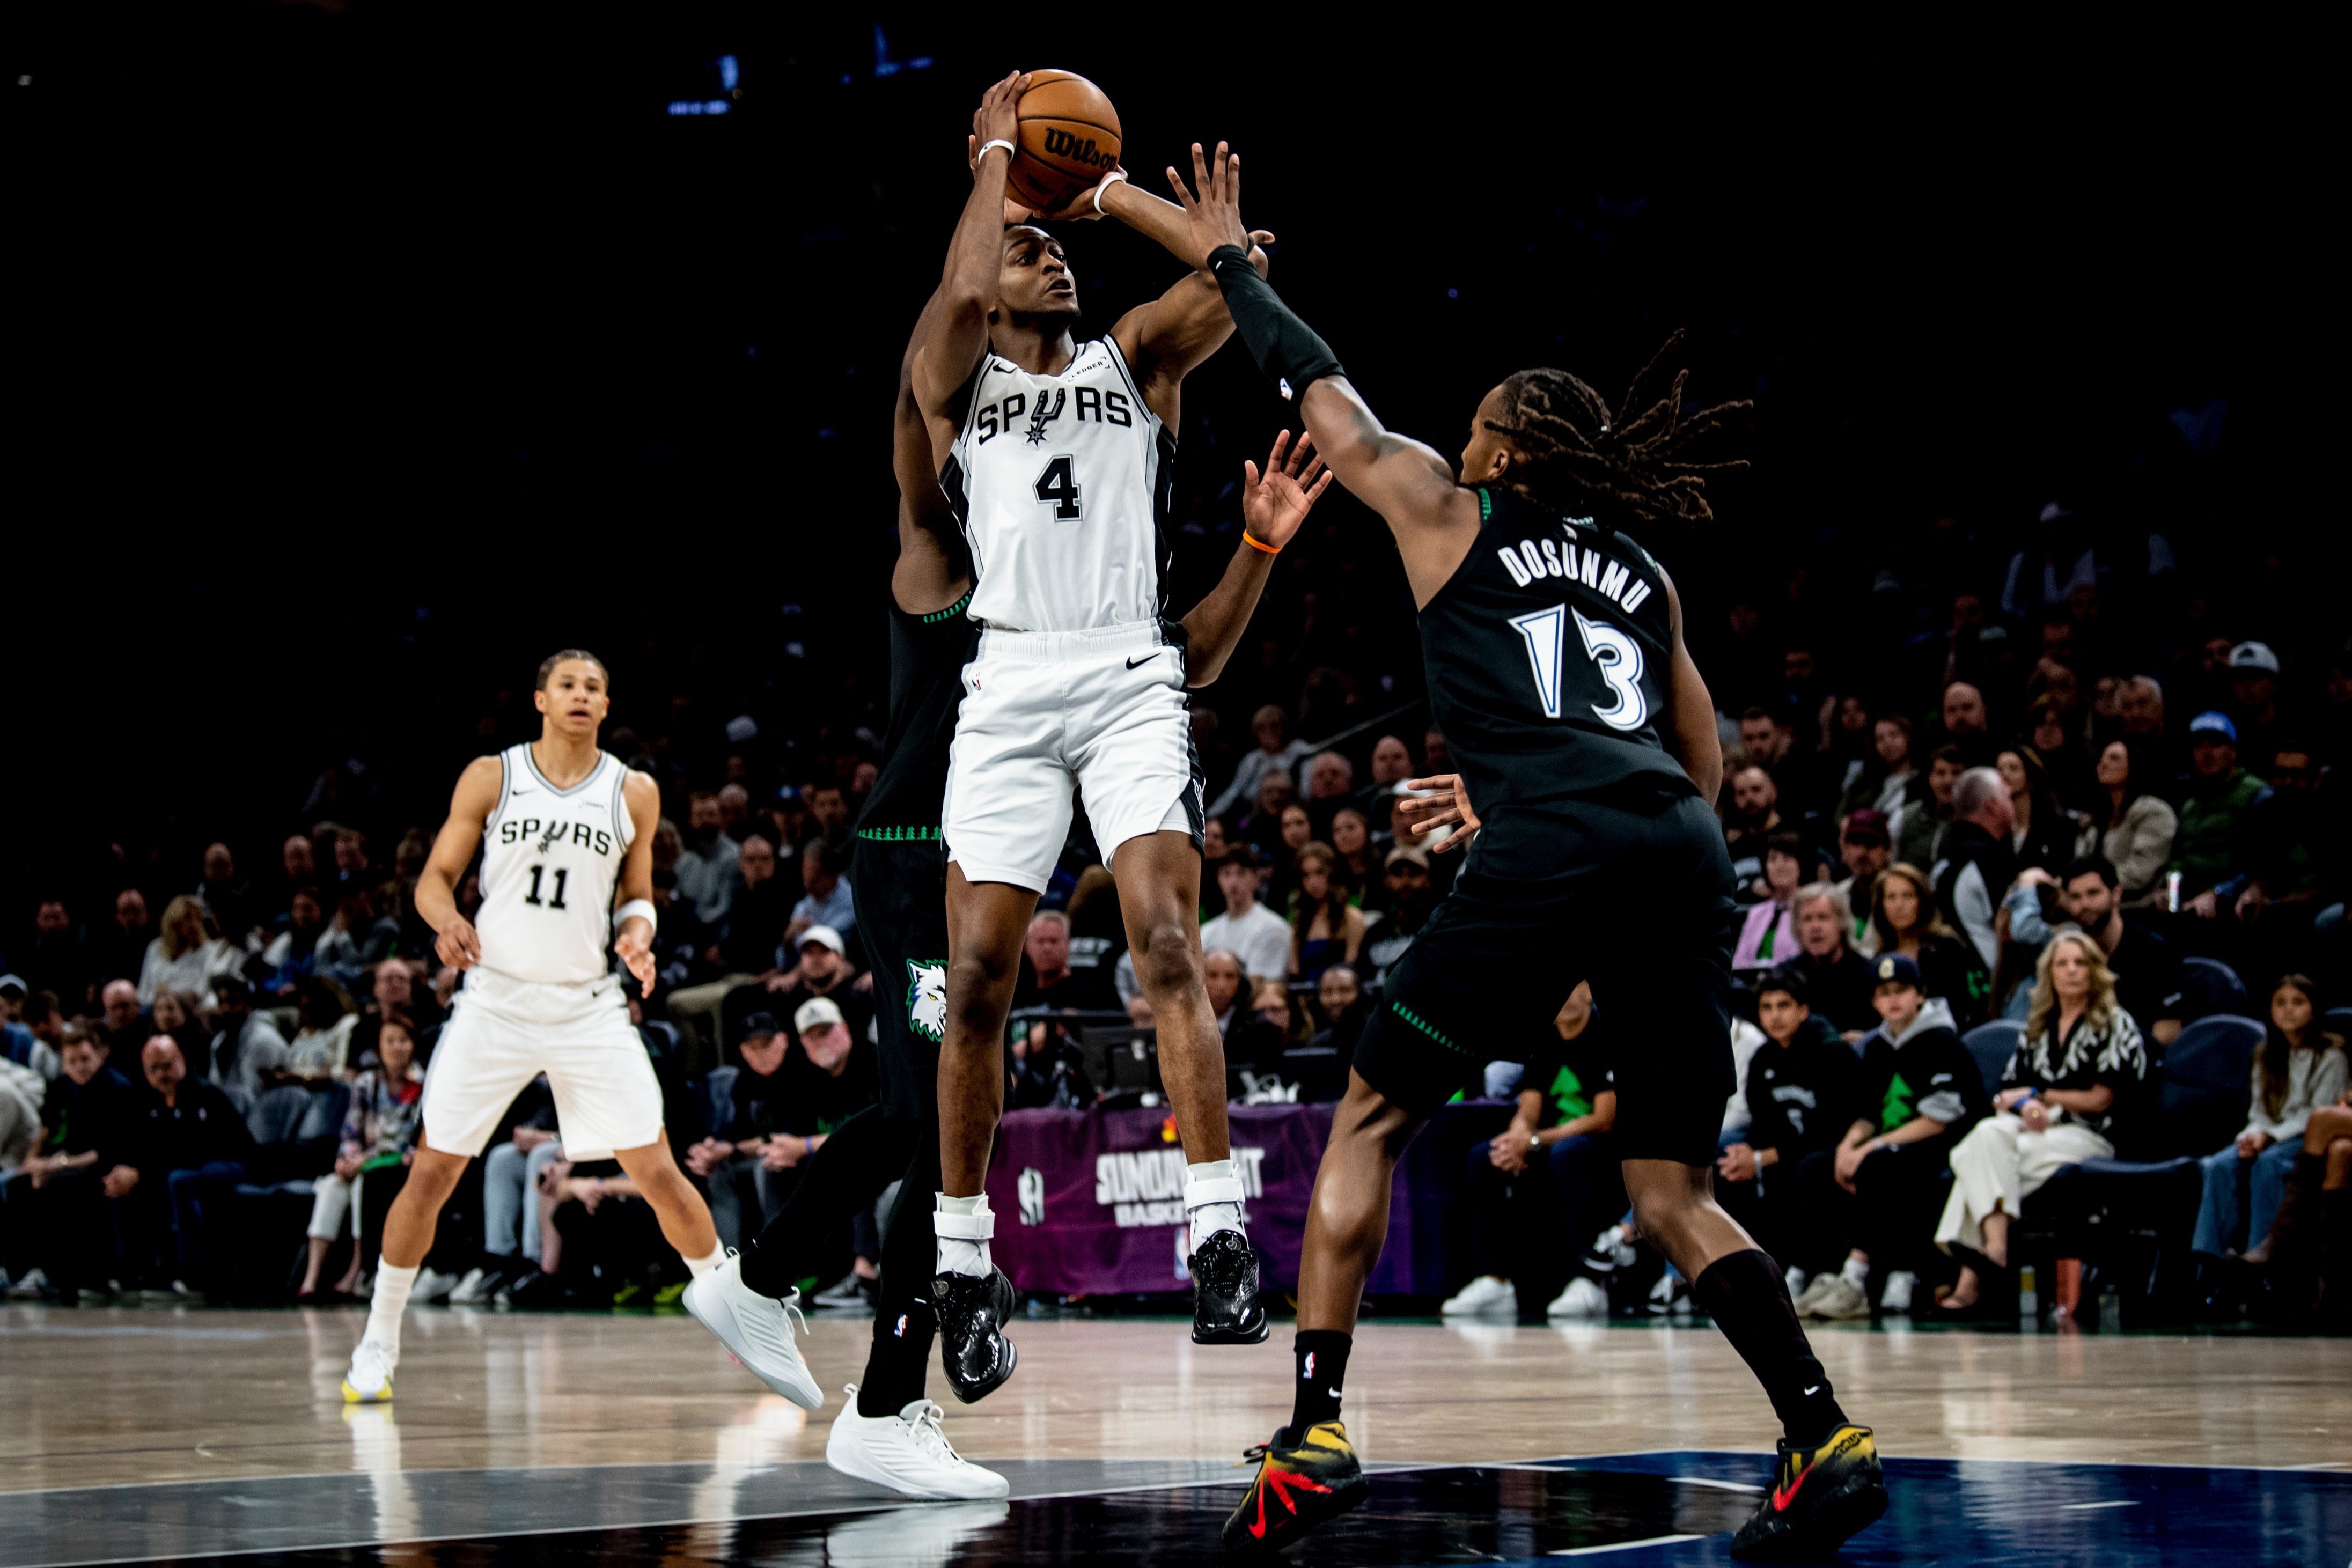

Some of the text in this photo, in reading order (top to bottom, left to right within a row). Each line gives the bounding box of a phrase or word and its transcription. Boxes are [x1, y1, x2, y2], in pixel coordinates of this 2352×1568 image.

[1045, 126, 1118, 171] Wilson
[1071, 361, 1104, 378] LEDGER
[977, 386, 1132, 446] SPURS
[1033, 454, 1083, 522] 4
[1497, 538, 1652, 614] DOSUNMU
[1506, 602, 1647, 731] 13
[502, 819, 611, 855] SPURS
[525, 865, 567, 909] 11
[1096, 1149, 1187, 1204] SUNDA
